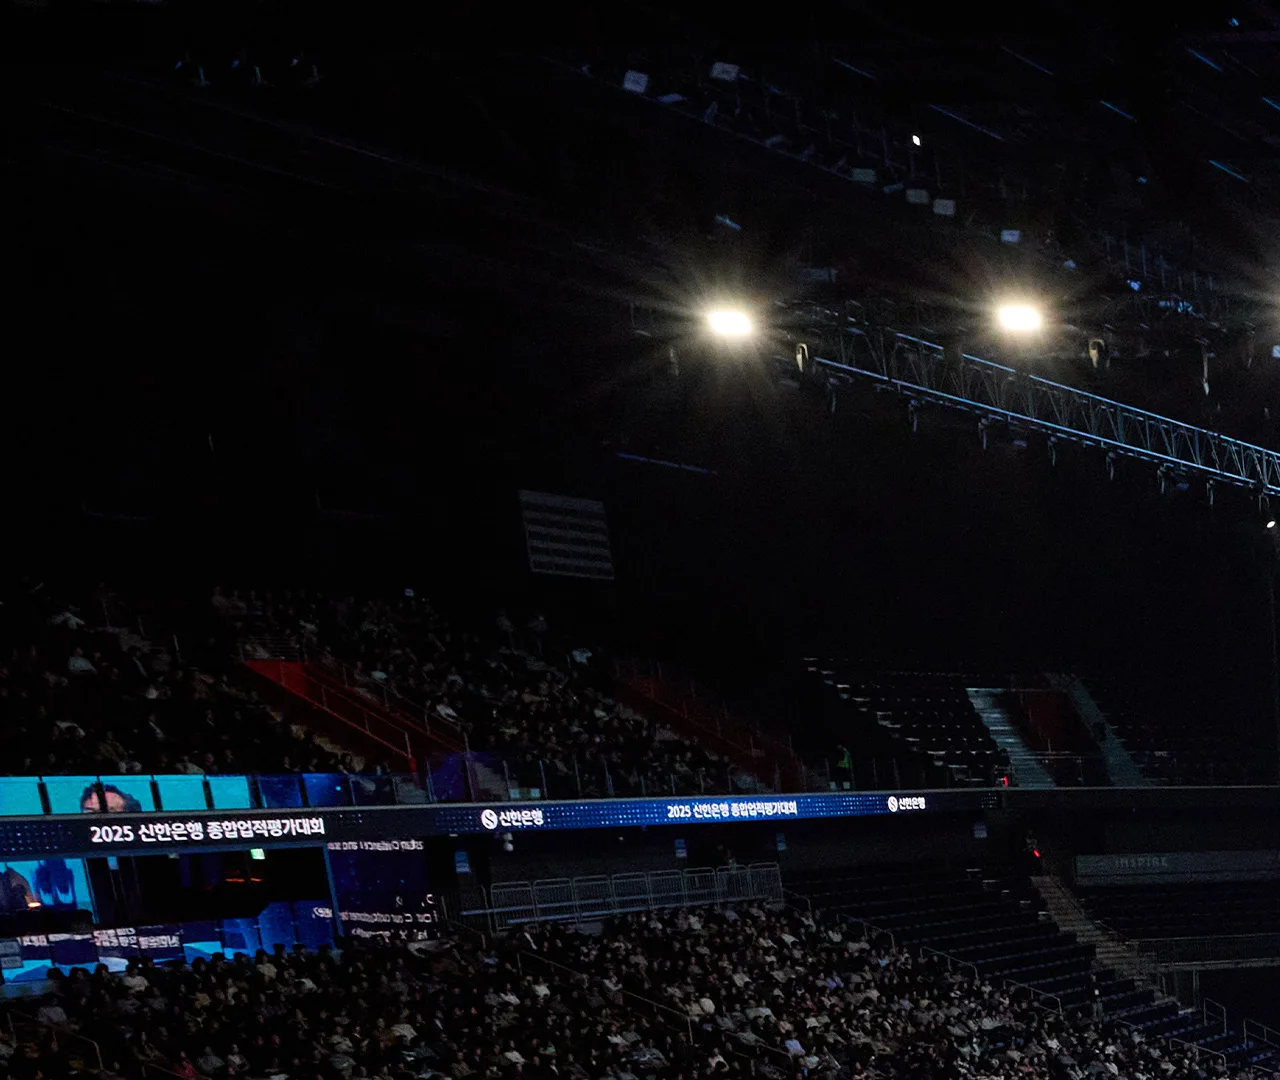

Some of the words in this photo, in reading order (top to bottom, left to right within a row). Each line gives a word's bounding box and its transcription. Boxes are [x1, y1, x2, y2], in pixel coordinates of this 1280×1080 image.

[667, 805, 691, 818] 2025
[693, 802, 729, 818] 신한은행
[731, 800, 797, 818] 종합업적평가대회
[898, 797, 926, 810] 신한은행
[499, 809, 544, 827] 신한은행
[90, 825, 134, 844] 2025
[138, 822, 203, 843] 신한은행
[207, 818, 325, 840] 종합업적평가대회
